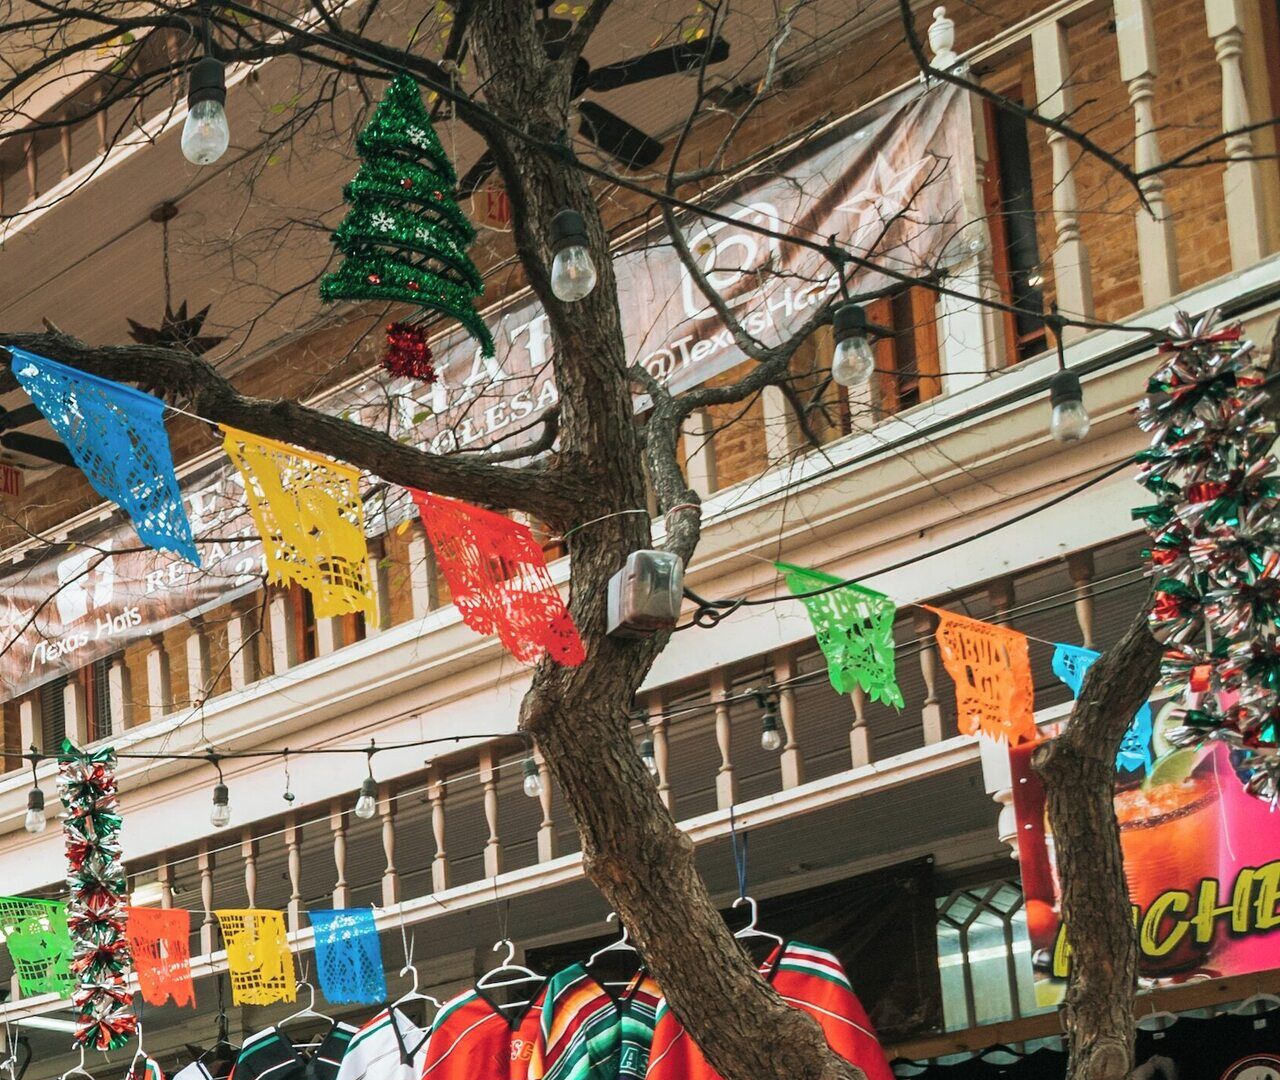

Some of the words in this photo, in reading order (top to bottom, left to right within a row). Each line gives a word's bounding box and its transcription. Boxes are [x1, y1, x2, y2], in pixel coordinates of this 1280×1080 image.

[641, 271, 840, 385] @TexsHats
[143, 523, 263, 595] REAIL
[29, 628, 90, 674] Texas
[93, 605, 143, 641] Hats
